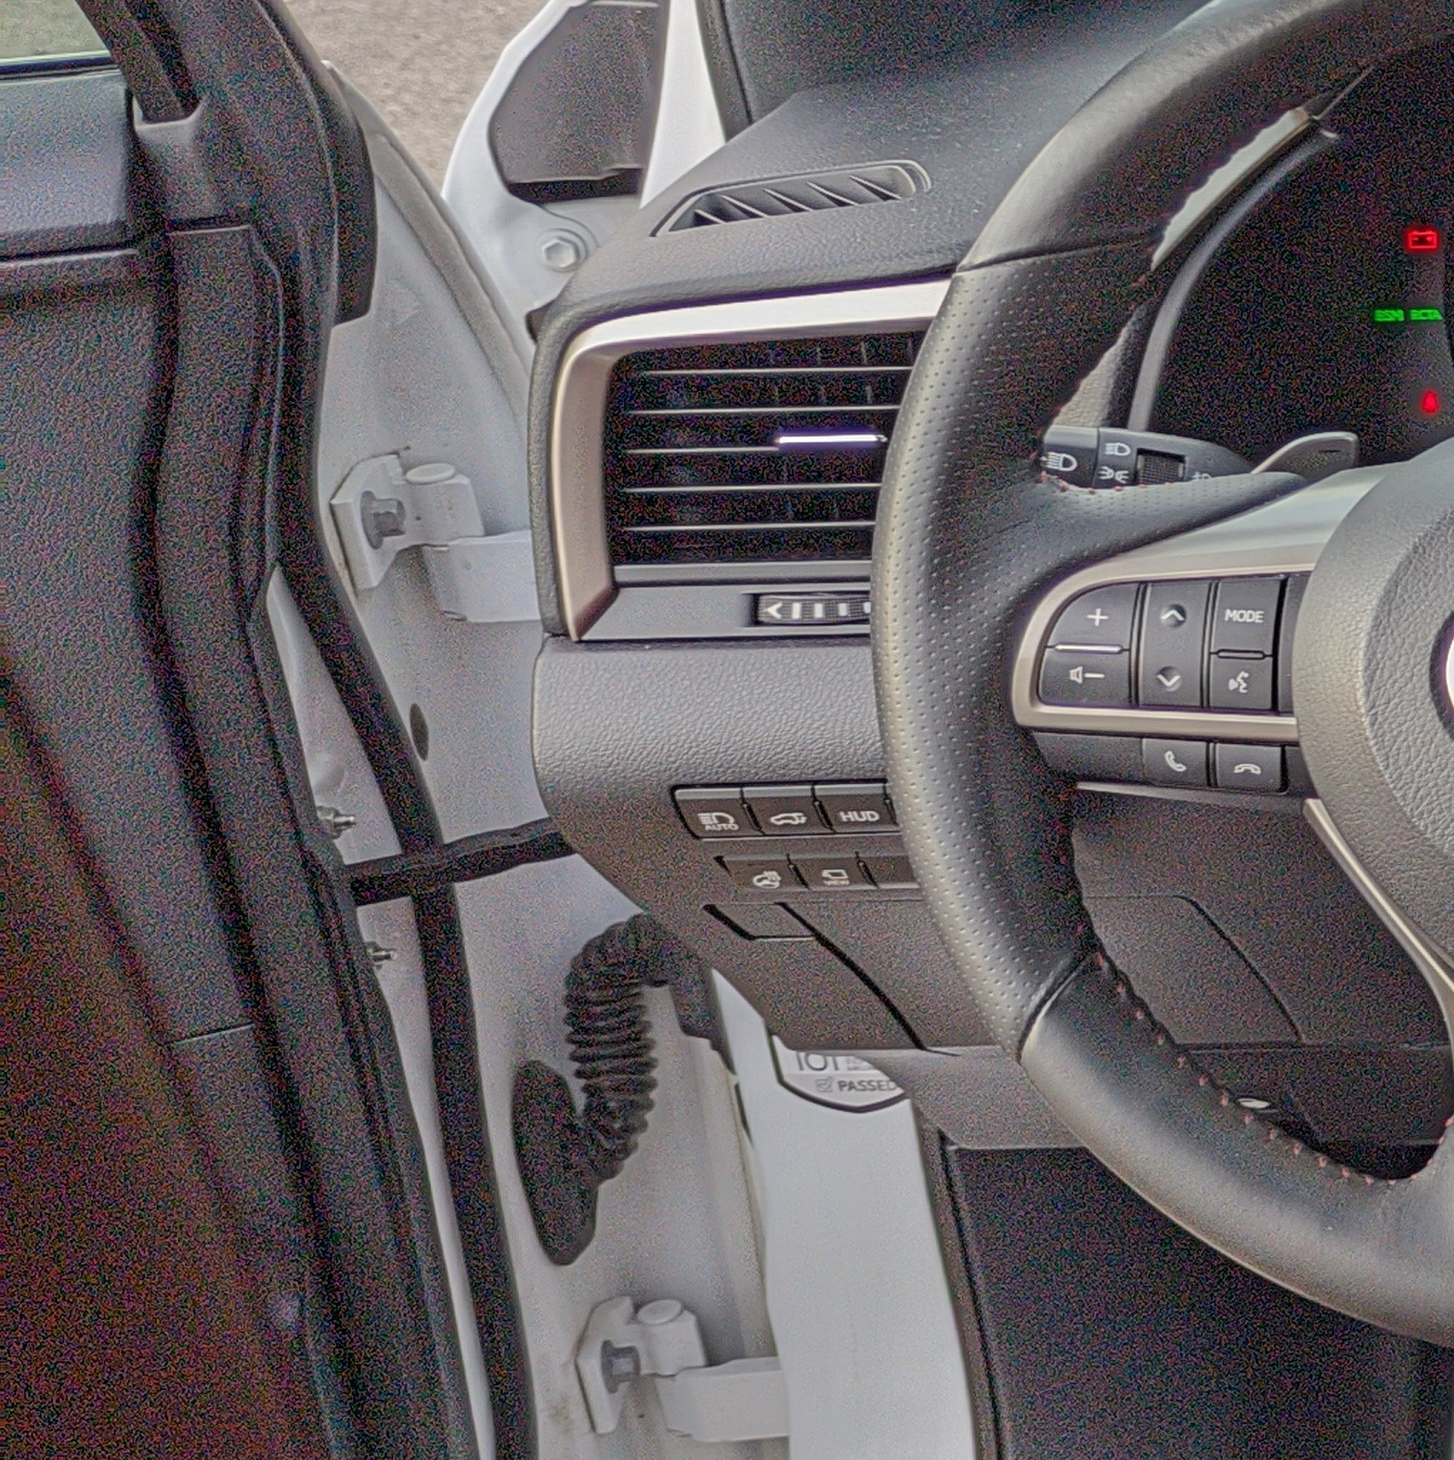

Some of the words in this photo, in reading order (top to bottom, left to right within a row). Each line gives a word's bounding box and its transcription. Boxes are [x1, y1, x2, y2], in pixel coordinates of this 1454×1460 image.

[1224, 609, 1264, 623] MODE
[840, 811, 880, 822] HUD
[705, 822, 739, 832] AUTO
[837, 1080, 898, 1092] PASSED
